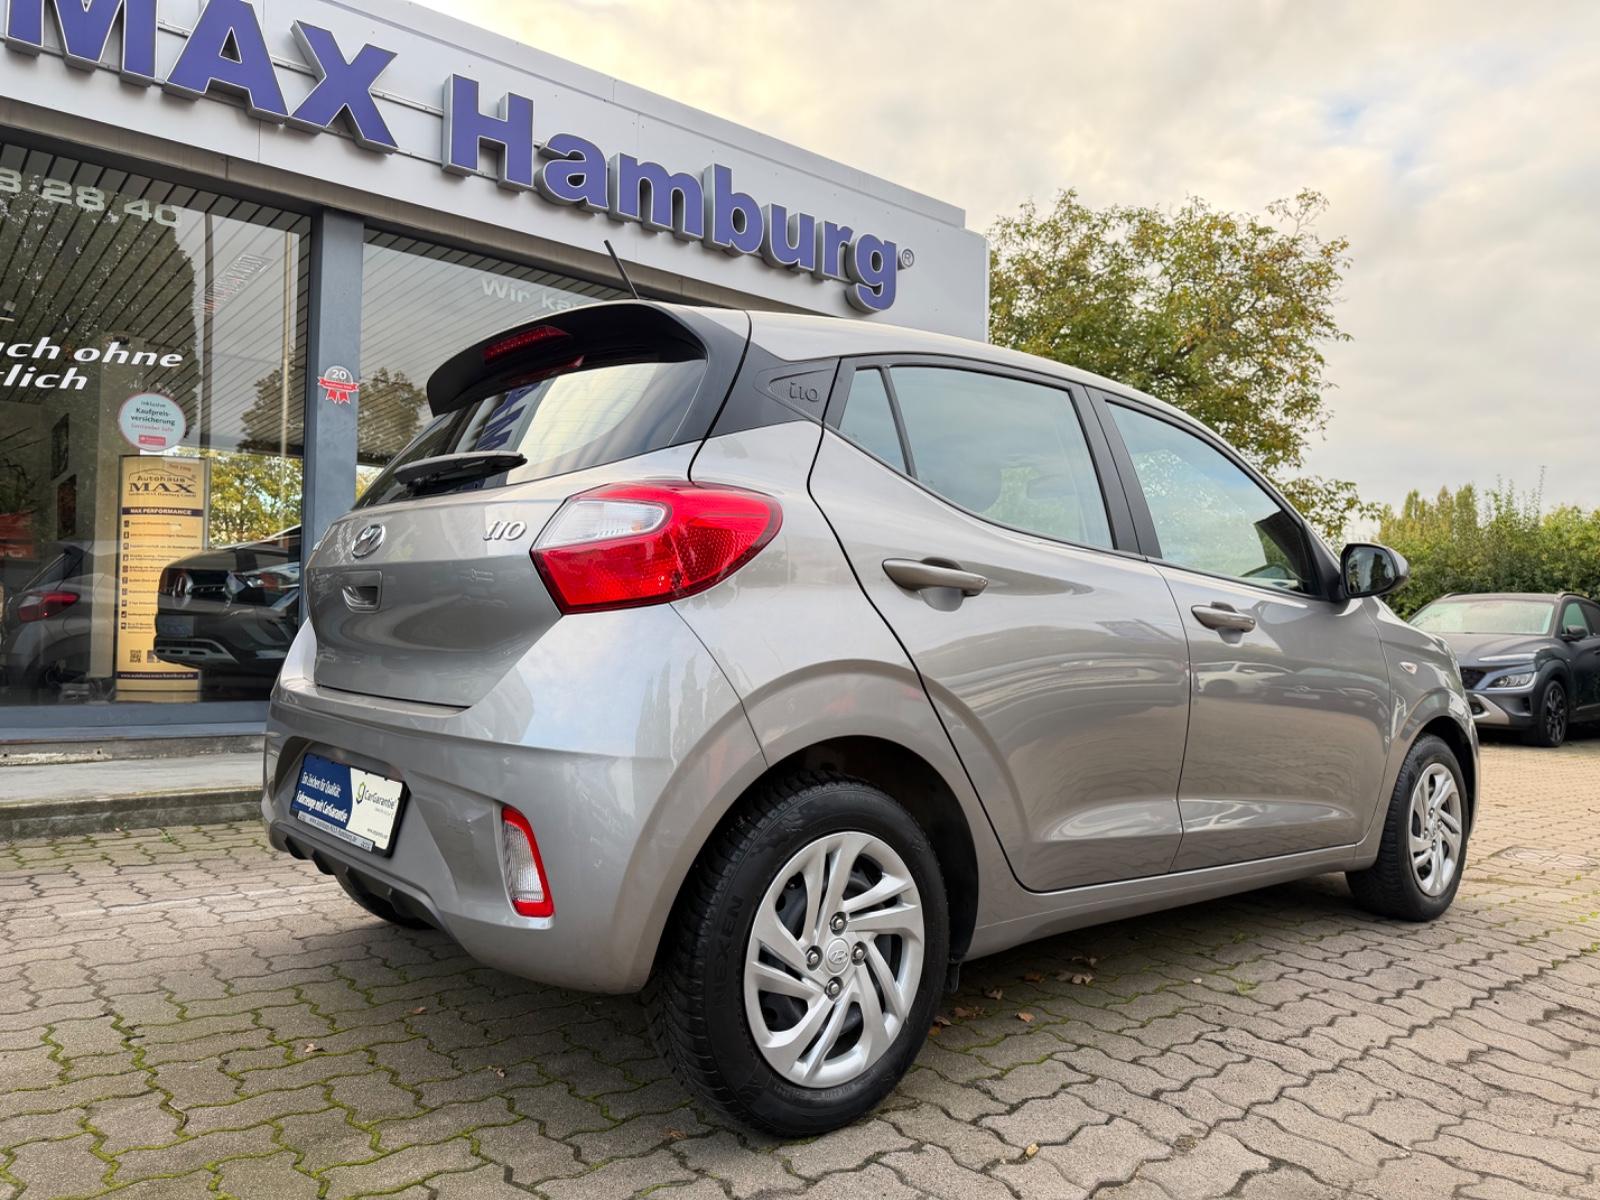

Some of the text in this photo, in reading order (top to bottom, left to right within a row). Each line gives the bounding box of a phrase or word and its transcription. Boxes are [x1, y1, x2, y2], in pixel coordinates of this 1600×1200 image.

[7, 0, 898, 312] MAX Hamburg
[41, 178, 105, 212] 28
[123, 199, 184, 228] 40
[480, 276, 531, 303] Wir
[73, 341, 184, 367] ohne
[332, 369, 347, 380] 20
[131, 415, 176, 426] versicherung
[129, 482, 196, 494] MAX
[137, 475, 186, 483] Autohaus
[483, 520, 527, 541] i10
